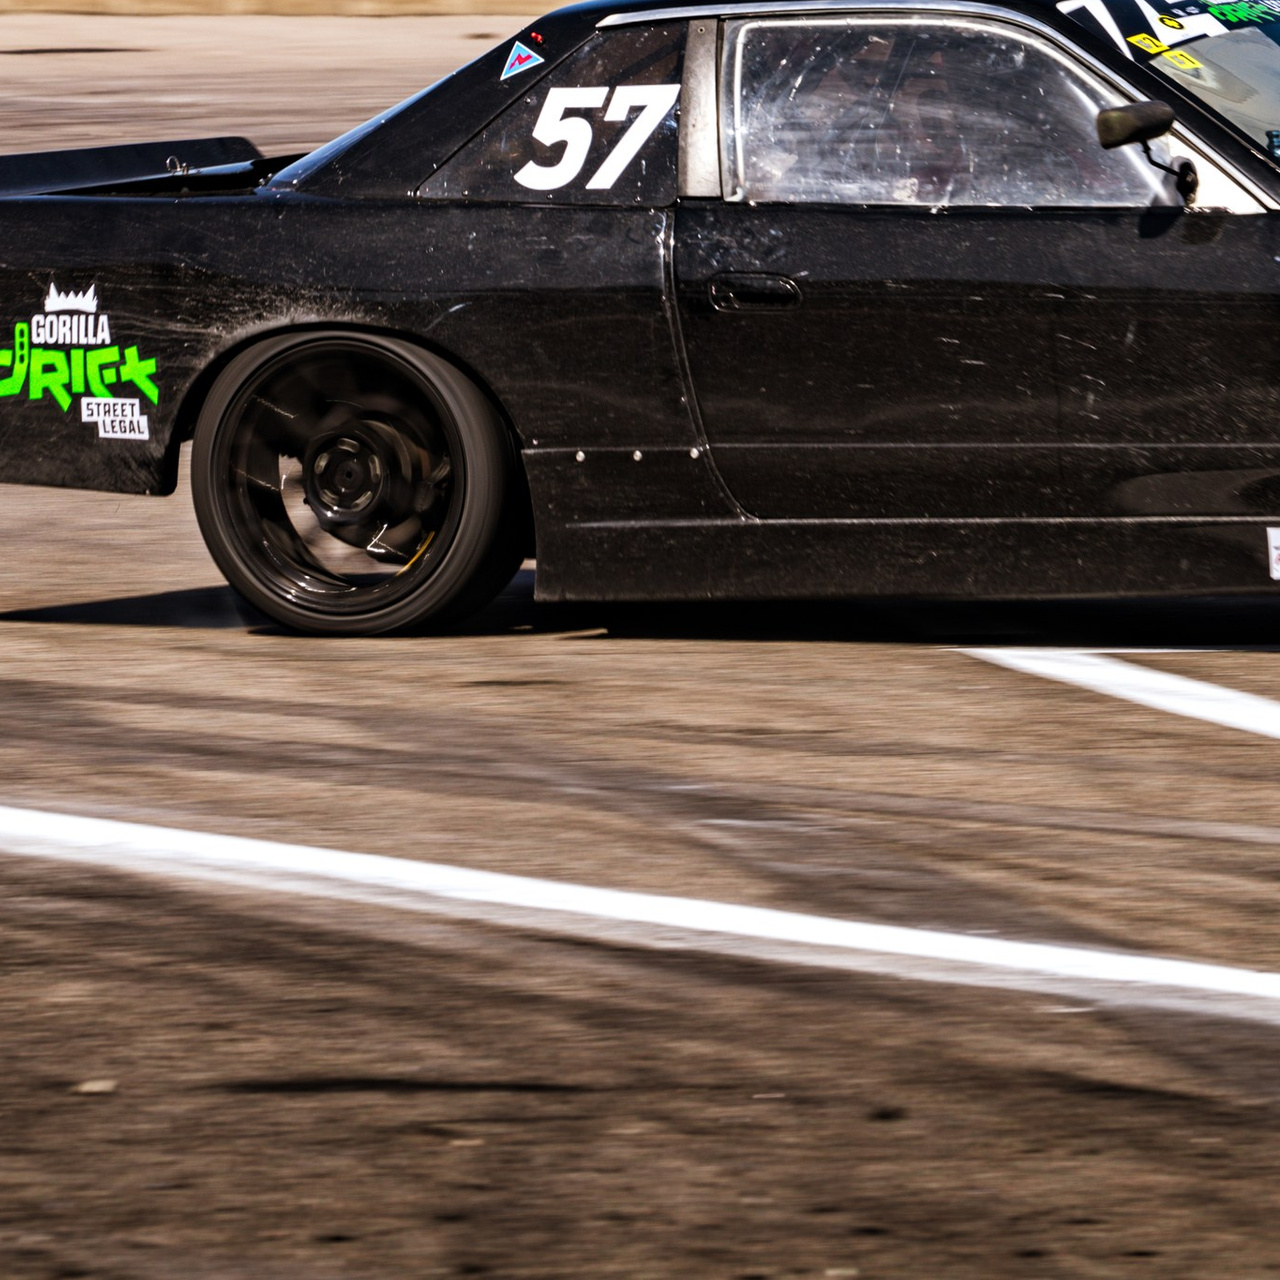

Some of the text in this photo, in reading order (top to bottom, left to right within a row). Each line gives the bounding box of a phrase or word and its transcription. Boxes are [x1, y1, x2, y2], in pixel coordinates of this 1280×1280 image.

[513, 83, 682, 191] 57
[31, 314, 111, 345] GORILLA
[86, 402, 136, 418] STREET
[103, 421, 145, 434] LEGAL
